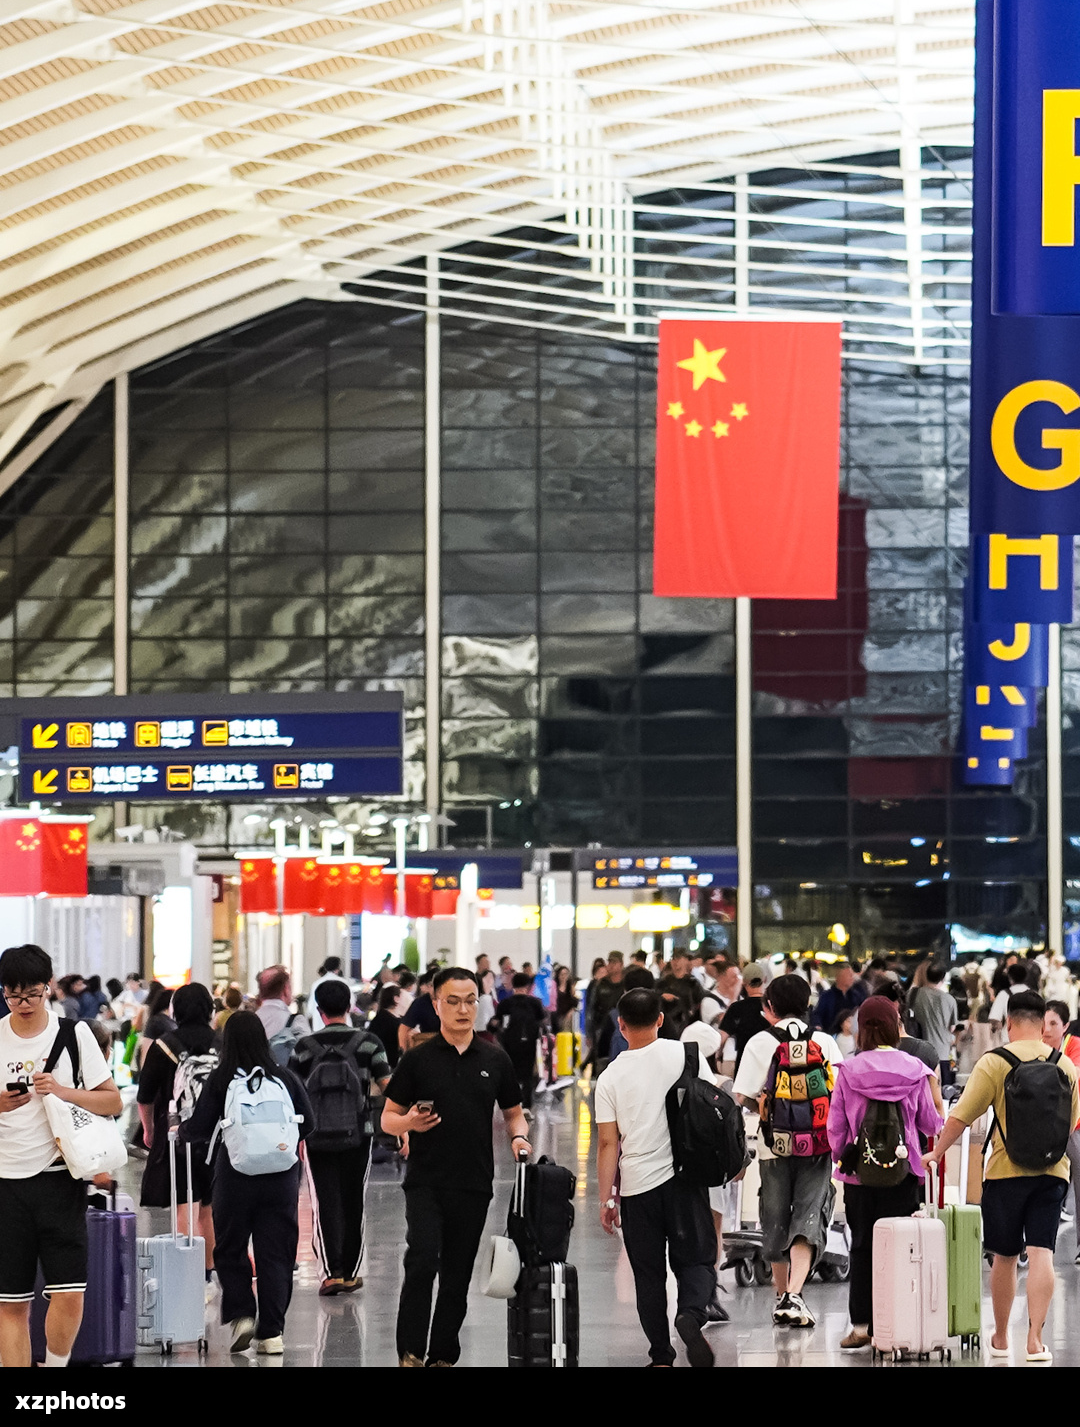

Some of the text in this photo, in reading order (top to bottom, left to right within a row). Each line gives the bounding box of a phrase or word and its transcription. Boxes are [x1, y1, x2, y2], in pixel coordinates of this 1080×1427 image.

[988, 533, 1059, 590] H
[92, 765, 159, 784] 机场巴士
[192, 764, 259, 782] 长途汽车
[792, 1044, 804, 1059] 2
[814, 1103, 826, 1121] 7
